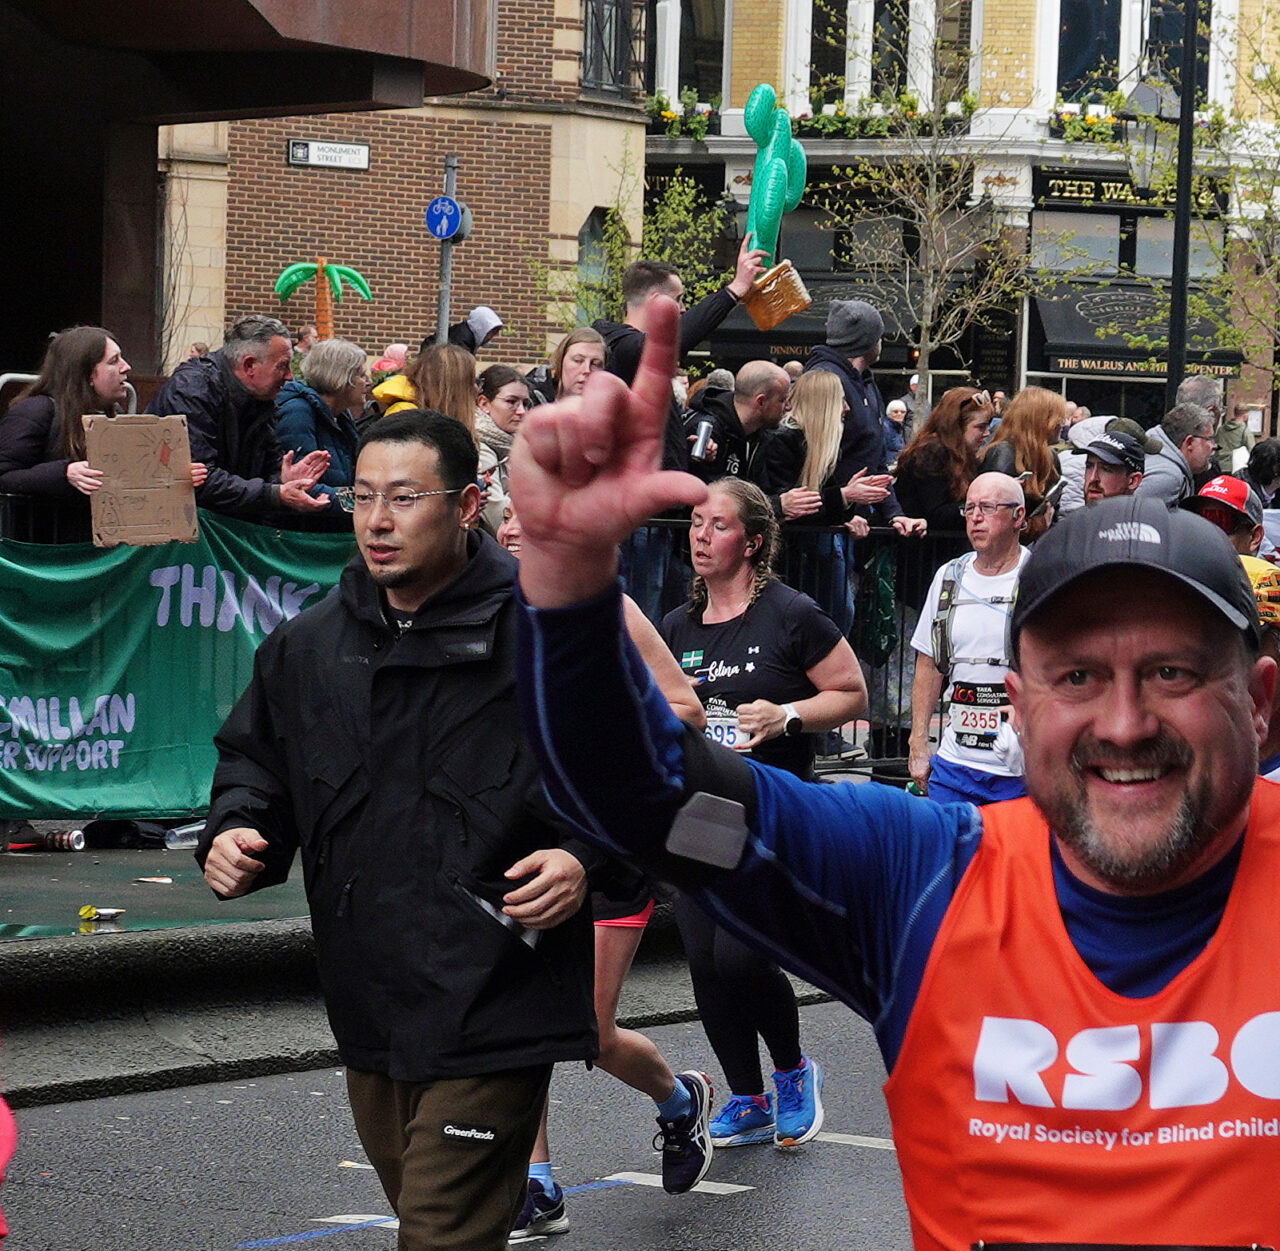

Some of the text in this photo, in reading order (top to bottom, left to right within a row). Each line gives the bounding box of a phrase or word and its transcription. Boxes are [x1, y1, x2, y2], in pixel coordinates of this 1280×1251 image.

[317, 146, 361, 155] MONUMENT
[1049, 179, 1095, 198] THE
[1058, 359, 1079, 369] THE
[1081, 360, 1124, 371] WALRUS
[150, 564, 320, 634] THANK
[694, 660, 740, 682] Selina
[961, 711, 998, 729] 2355
[705, 725, 737, 745] 695
[25, 739, 124, 771] SUPPORT
[969, 1118, 1030, 1143] Royal
[1034, 1124, 1118, 1150] Society
[1120, 1128, 1153, 1146] for
[1158, 1121, 1214, 1144] Blind
